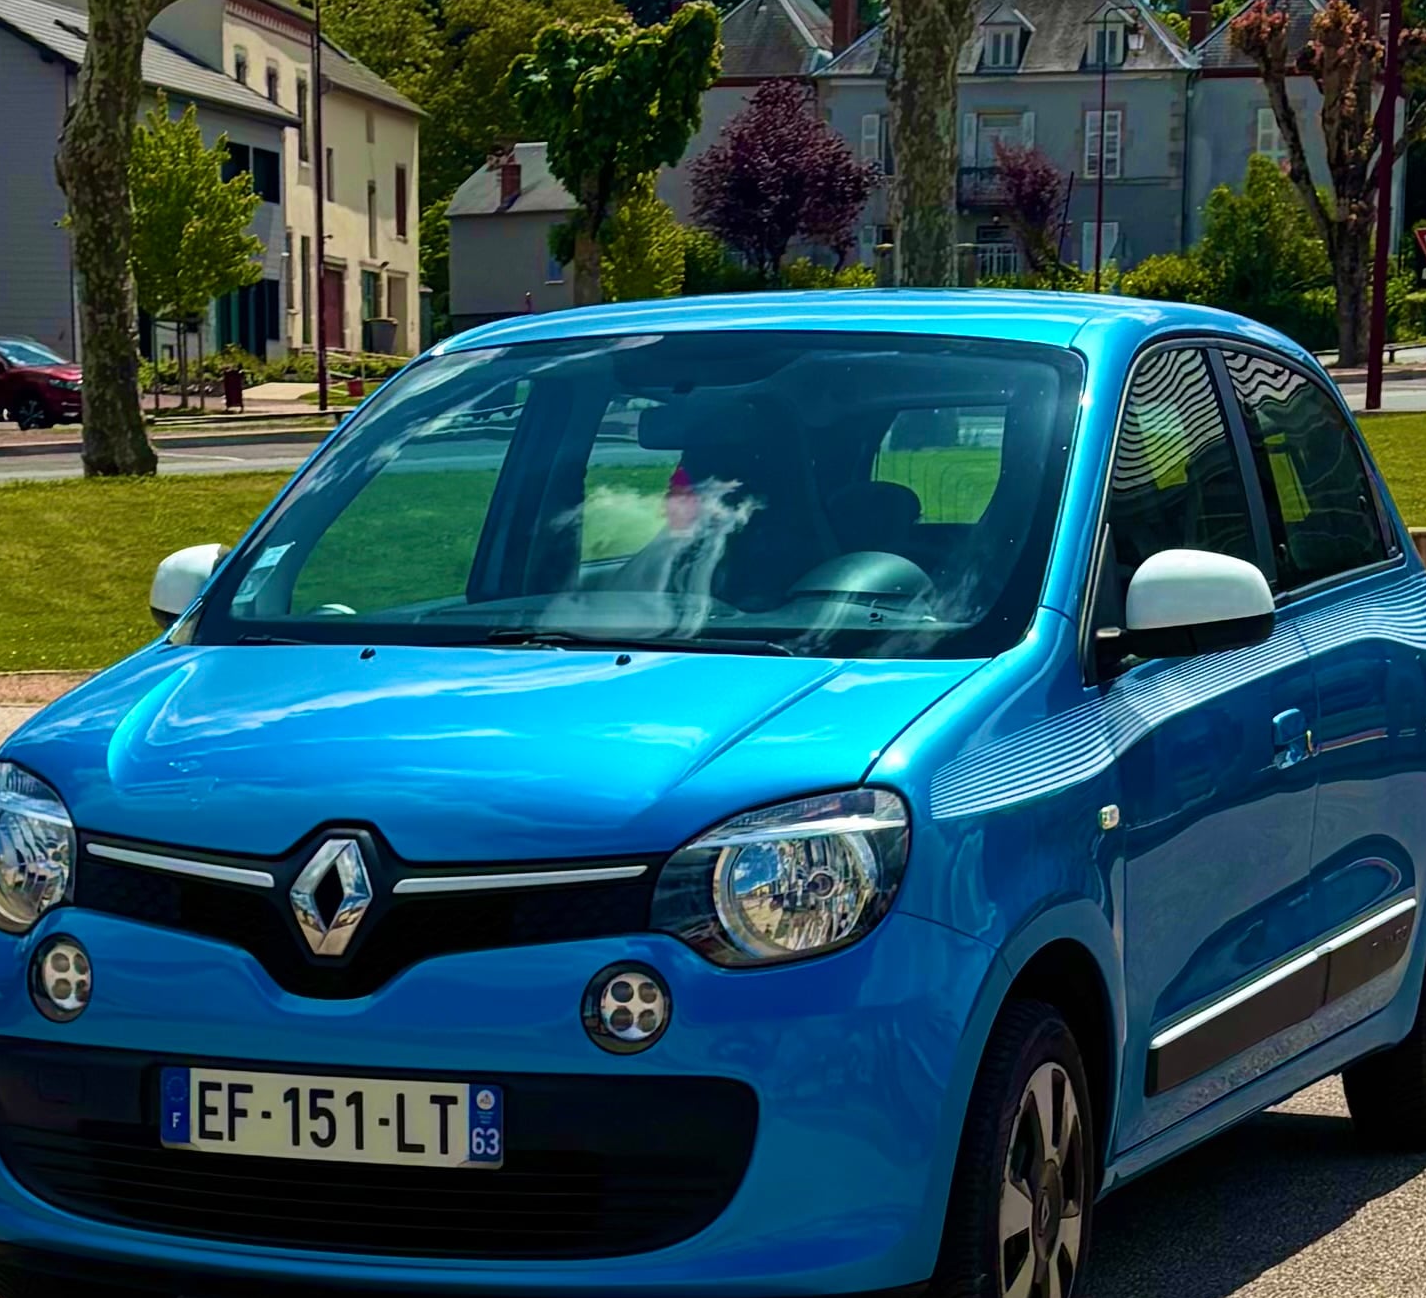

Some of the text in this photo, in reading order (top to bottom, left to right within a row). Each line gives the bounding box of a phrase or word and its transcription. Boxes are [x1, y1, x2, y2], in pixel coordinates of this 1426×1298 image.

[172, 1112, 181, 1128] F
[197, 1080, 459, 1155] EF-151-LT
[472, 1127, 500, 1155] 63
